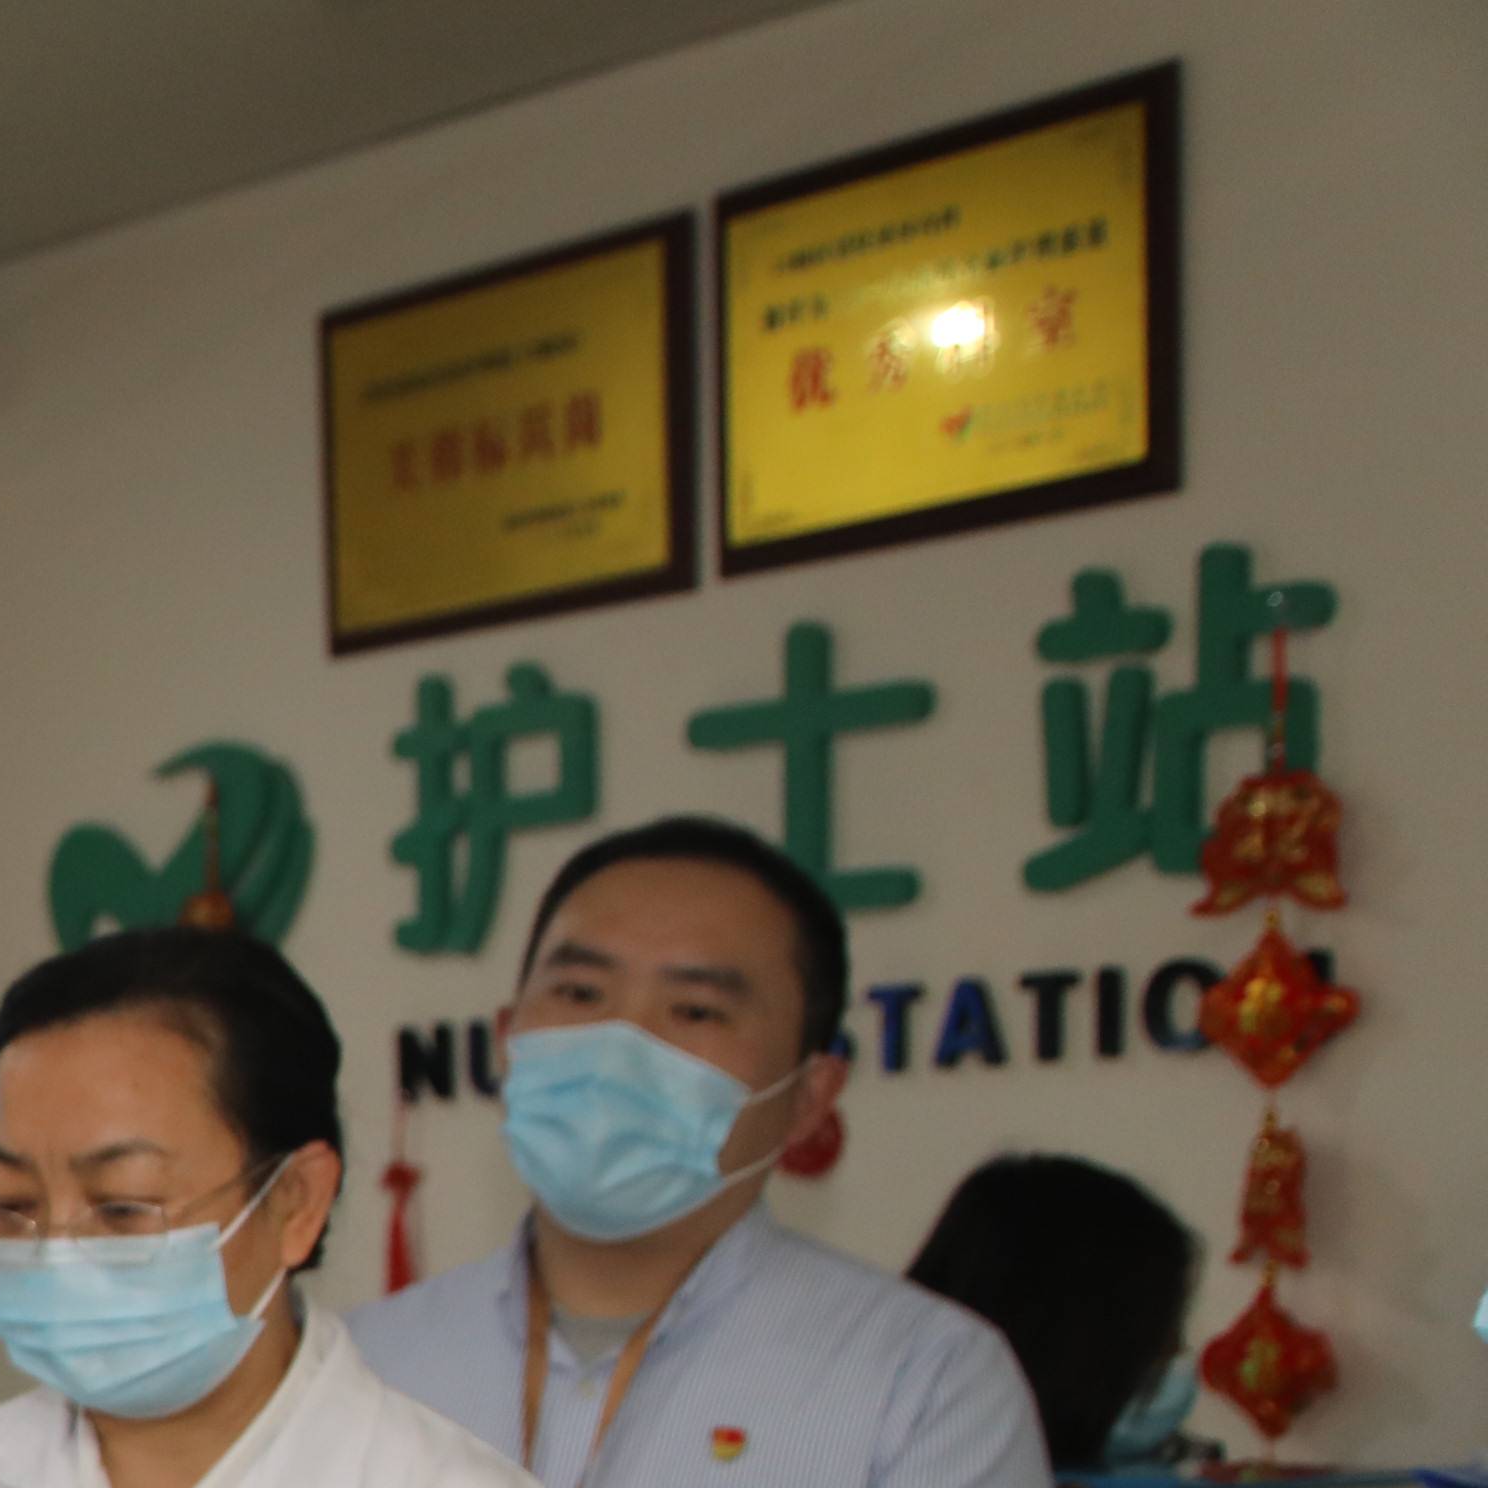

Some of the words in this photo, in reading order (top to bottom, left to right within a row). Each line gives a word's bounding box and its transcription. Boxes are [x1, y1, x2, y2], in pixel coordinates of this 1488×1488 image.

[390, 540, 1340, 957] 护士站
[832, 949, 1336, 1073] TATIO
